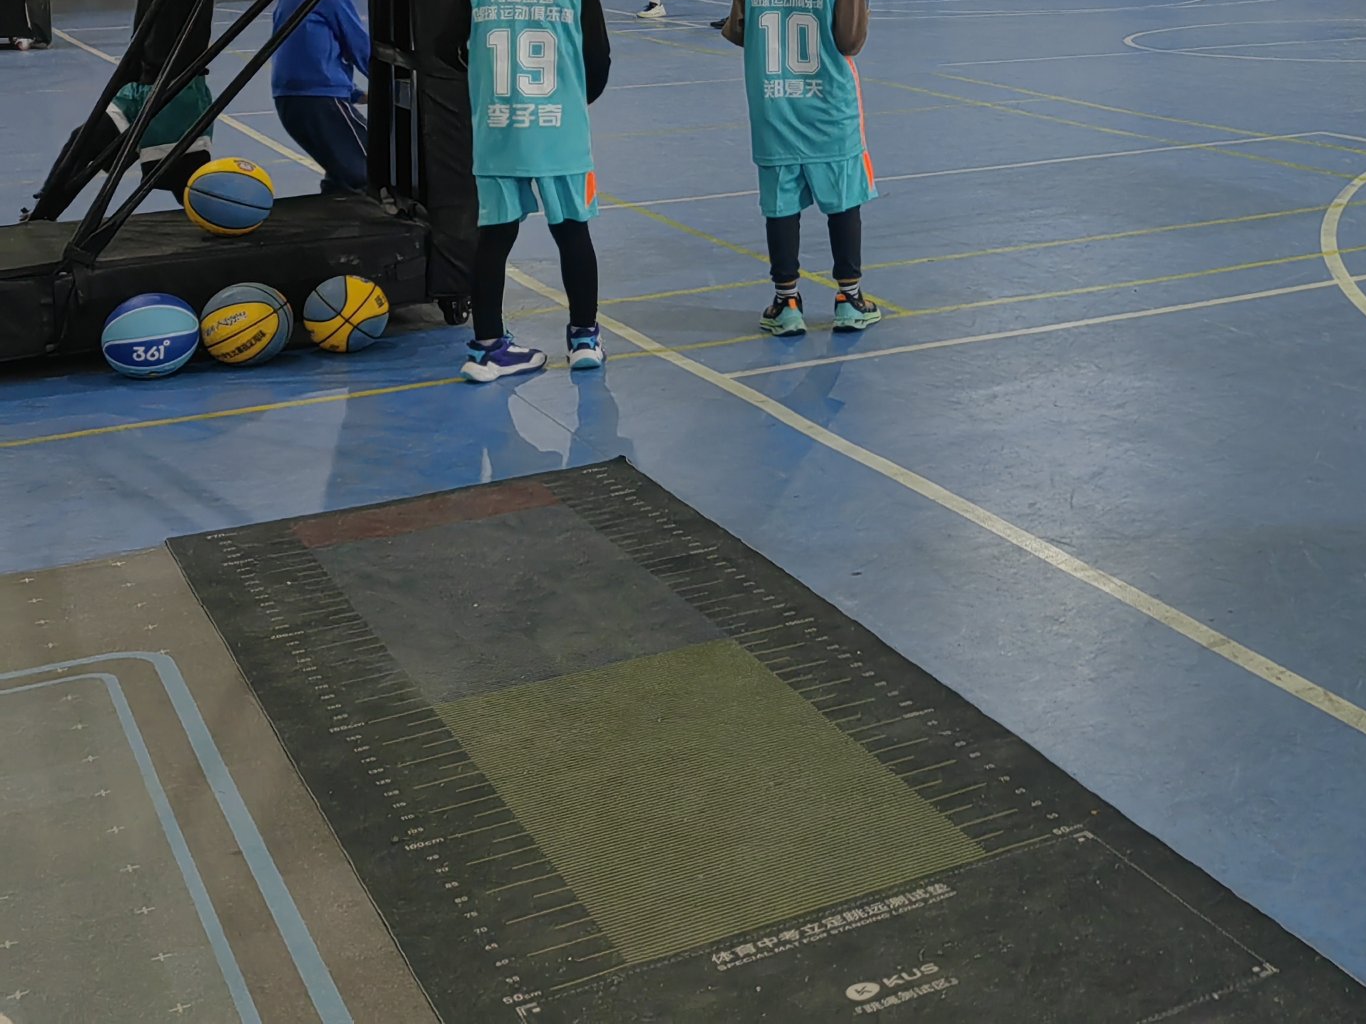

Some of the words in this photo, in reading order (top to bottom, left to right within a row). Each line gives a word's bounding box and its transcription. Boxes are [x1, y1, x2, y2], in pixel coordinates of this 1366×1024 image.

[758, 11, 821, 75] 10
[487, 28, 558, 98] 19
[763, 79, 824, 99] 郑夏天
[487, 103, 563, 128] 李子奇
[132, 339, 171, 362] 361°
[717, 950, 774, 971] SPECIAL
[775, 941, 800, 954] MAT
[803, 933, 828, 944] FOR
[882, 962, 939, 987] KUS
